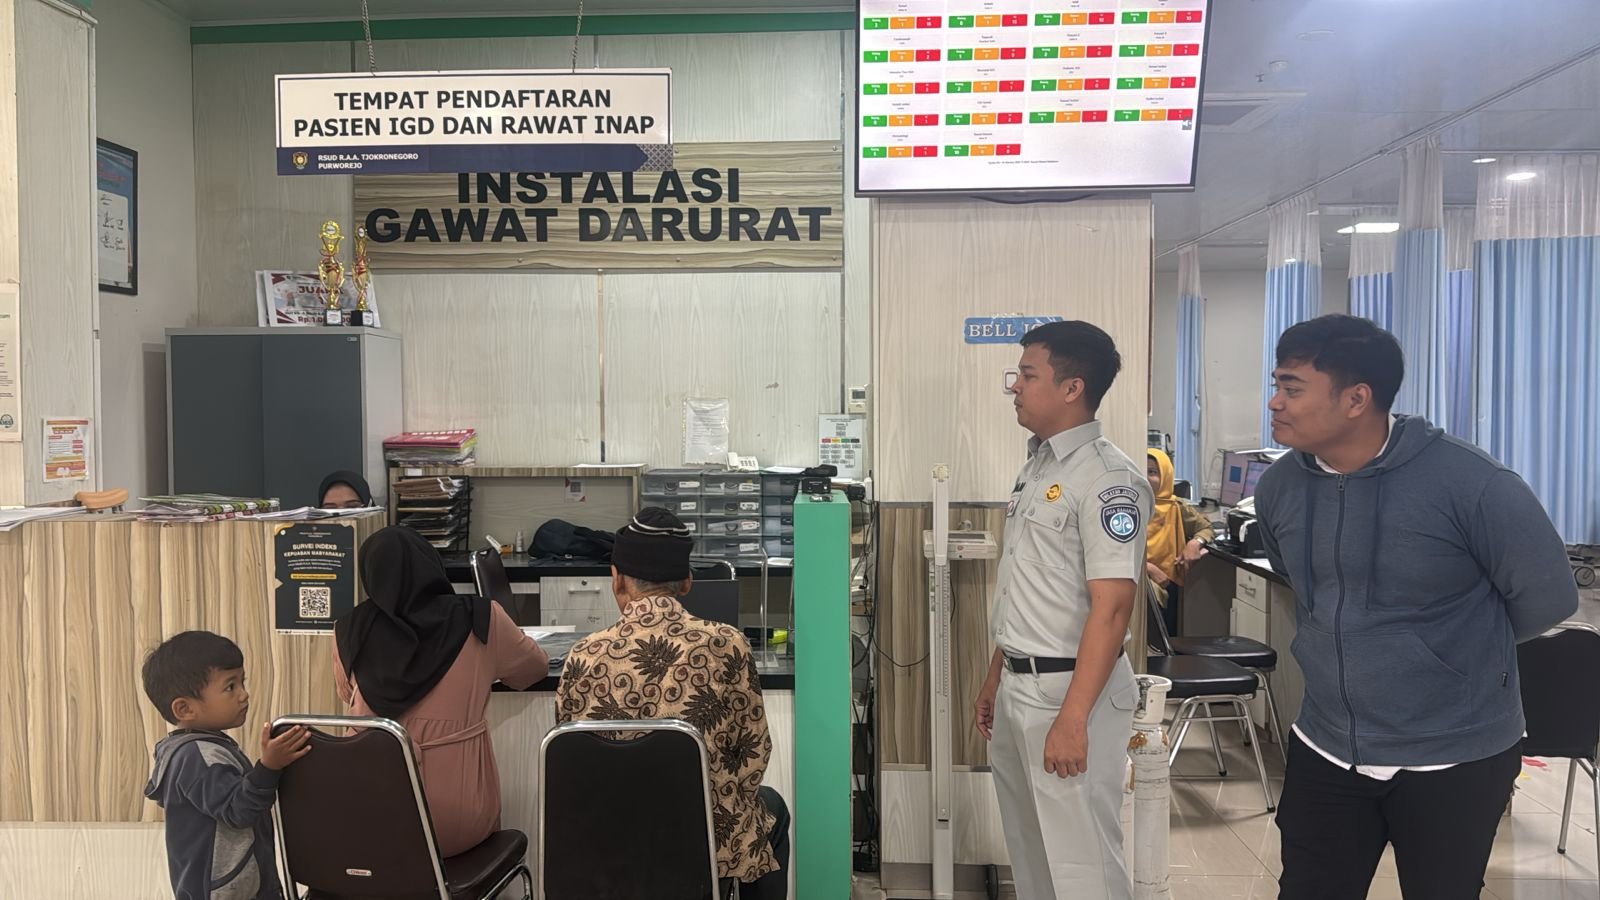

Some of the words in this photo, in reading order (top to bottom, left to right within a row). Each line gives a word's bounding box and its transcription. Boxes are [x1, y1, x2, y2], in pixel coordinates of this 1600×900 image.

[334, 91, 429, 110] TEMPAT
[437, 89, 611, 109] PENDAFTARAN
[294, 117, 381, 137] PASIEN
[389, 117, 435, 136] IGD
[443, 116, 492, 135] DAN
[501, 116, 587, 134] RAWAT
[594, 116, 655, 134] INAP
[457, 168, 740, 204] INSTALASI
[365, 208, 558, 243] GAWAT
[578, 207, 832, 241] DARURAT
[969, 323, 1017, 337] BELL
[311, 550, 346, 558] MASYARAKAT
